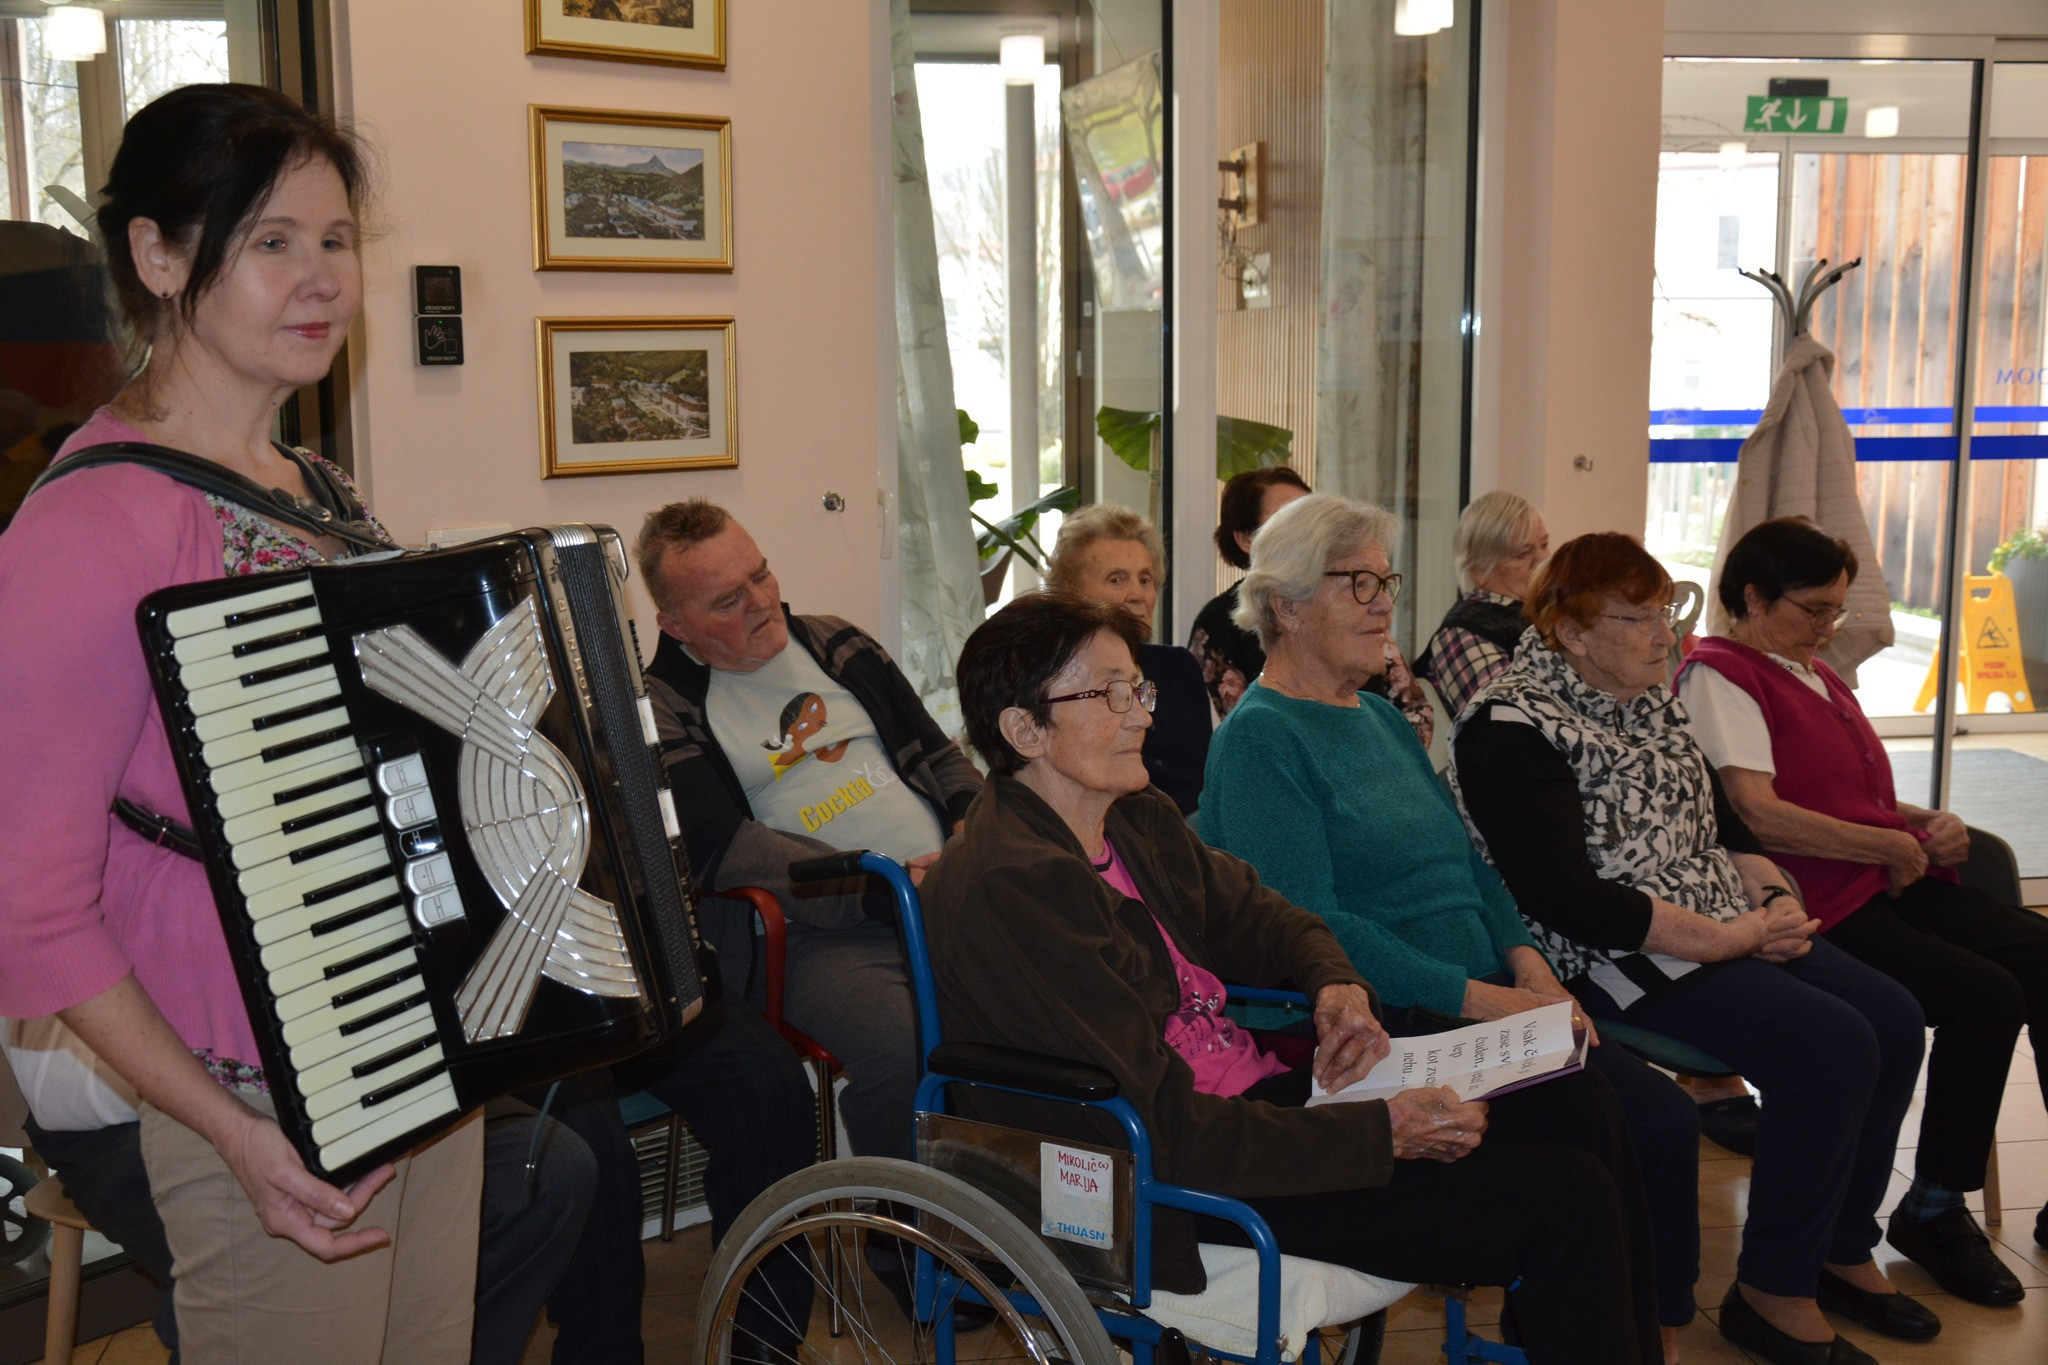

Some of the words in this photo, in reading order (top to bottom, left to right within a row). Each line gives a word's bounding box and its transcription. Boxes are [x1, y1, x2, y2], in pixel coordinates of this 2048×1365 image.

[799, 776, 875, 833] Cockta
[1499, 1028, 1511, 1049] zase
[1522, 1020, 1537, 1047] Vsak
[1426, 1048, 1442, 1065] kot
[1448, 1041, 1467, 1058] lep
[1472, 1035, 1489, 1069] čuden,
[1402, 1051, 1417, 1074] nebu
[1058, 1150, 1097, 1173] MIKOLIČ
[1059, 1168, 1099, 1193] MARIJA
[1057, 1221, 1106, 1241] THUASN
